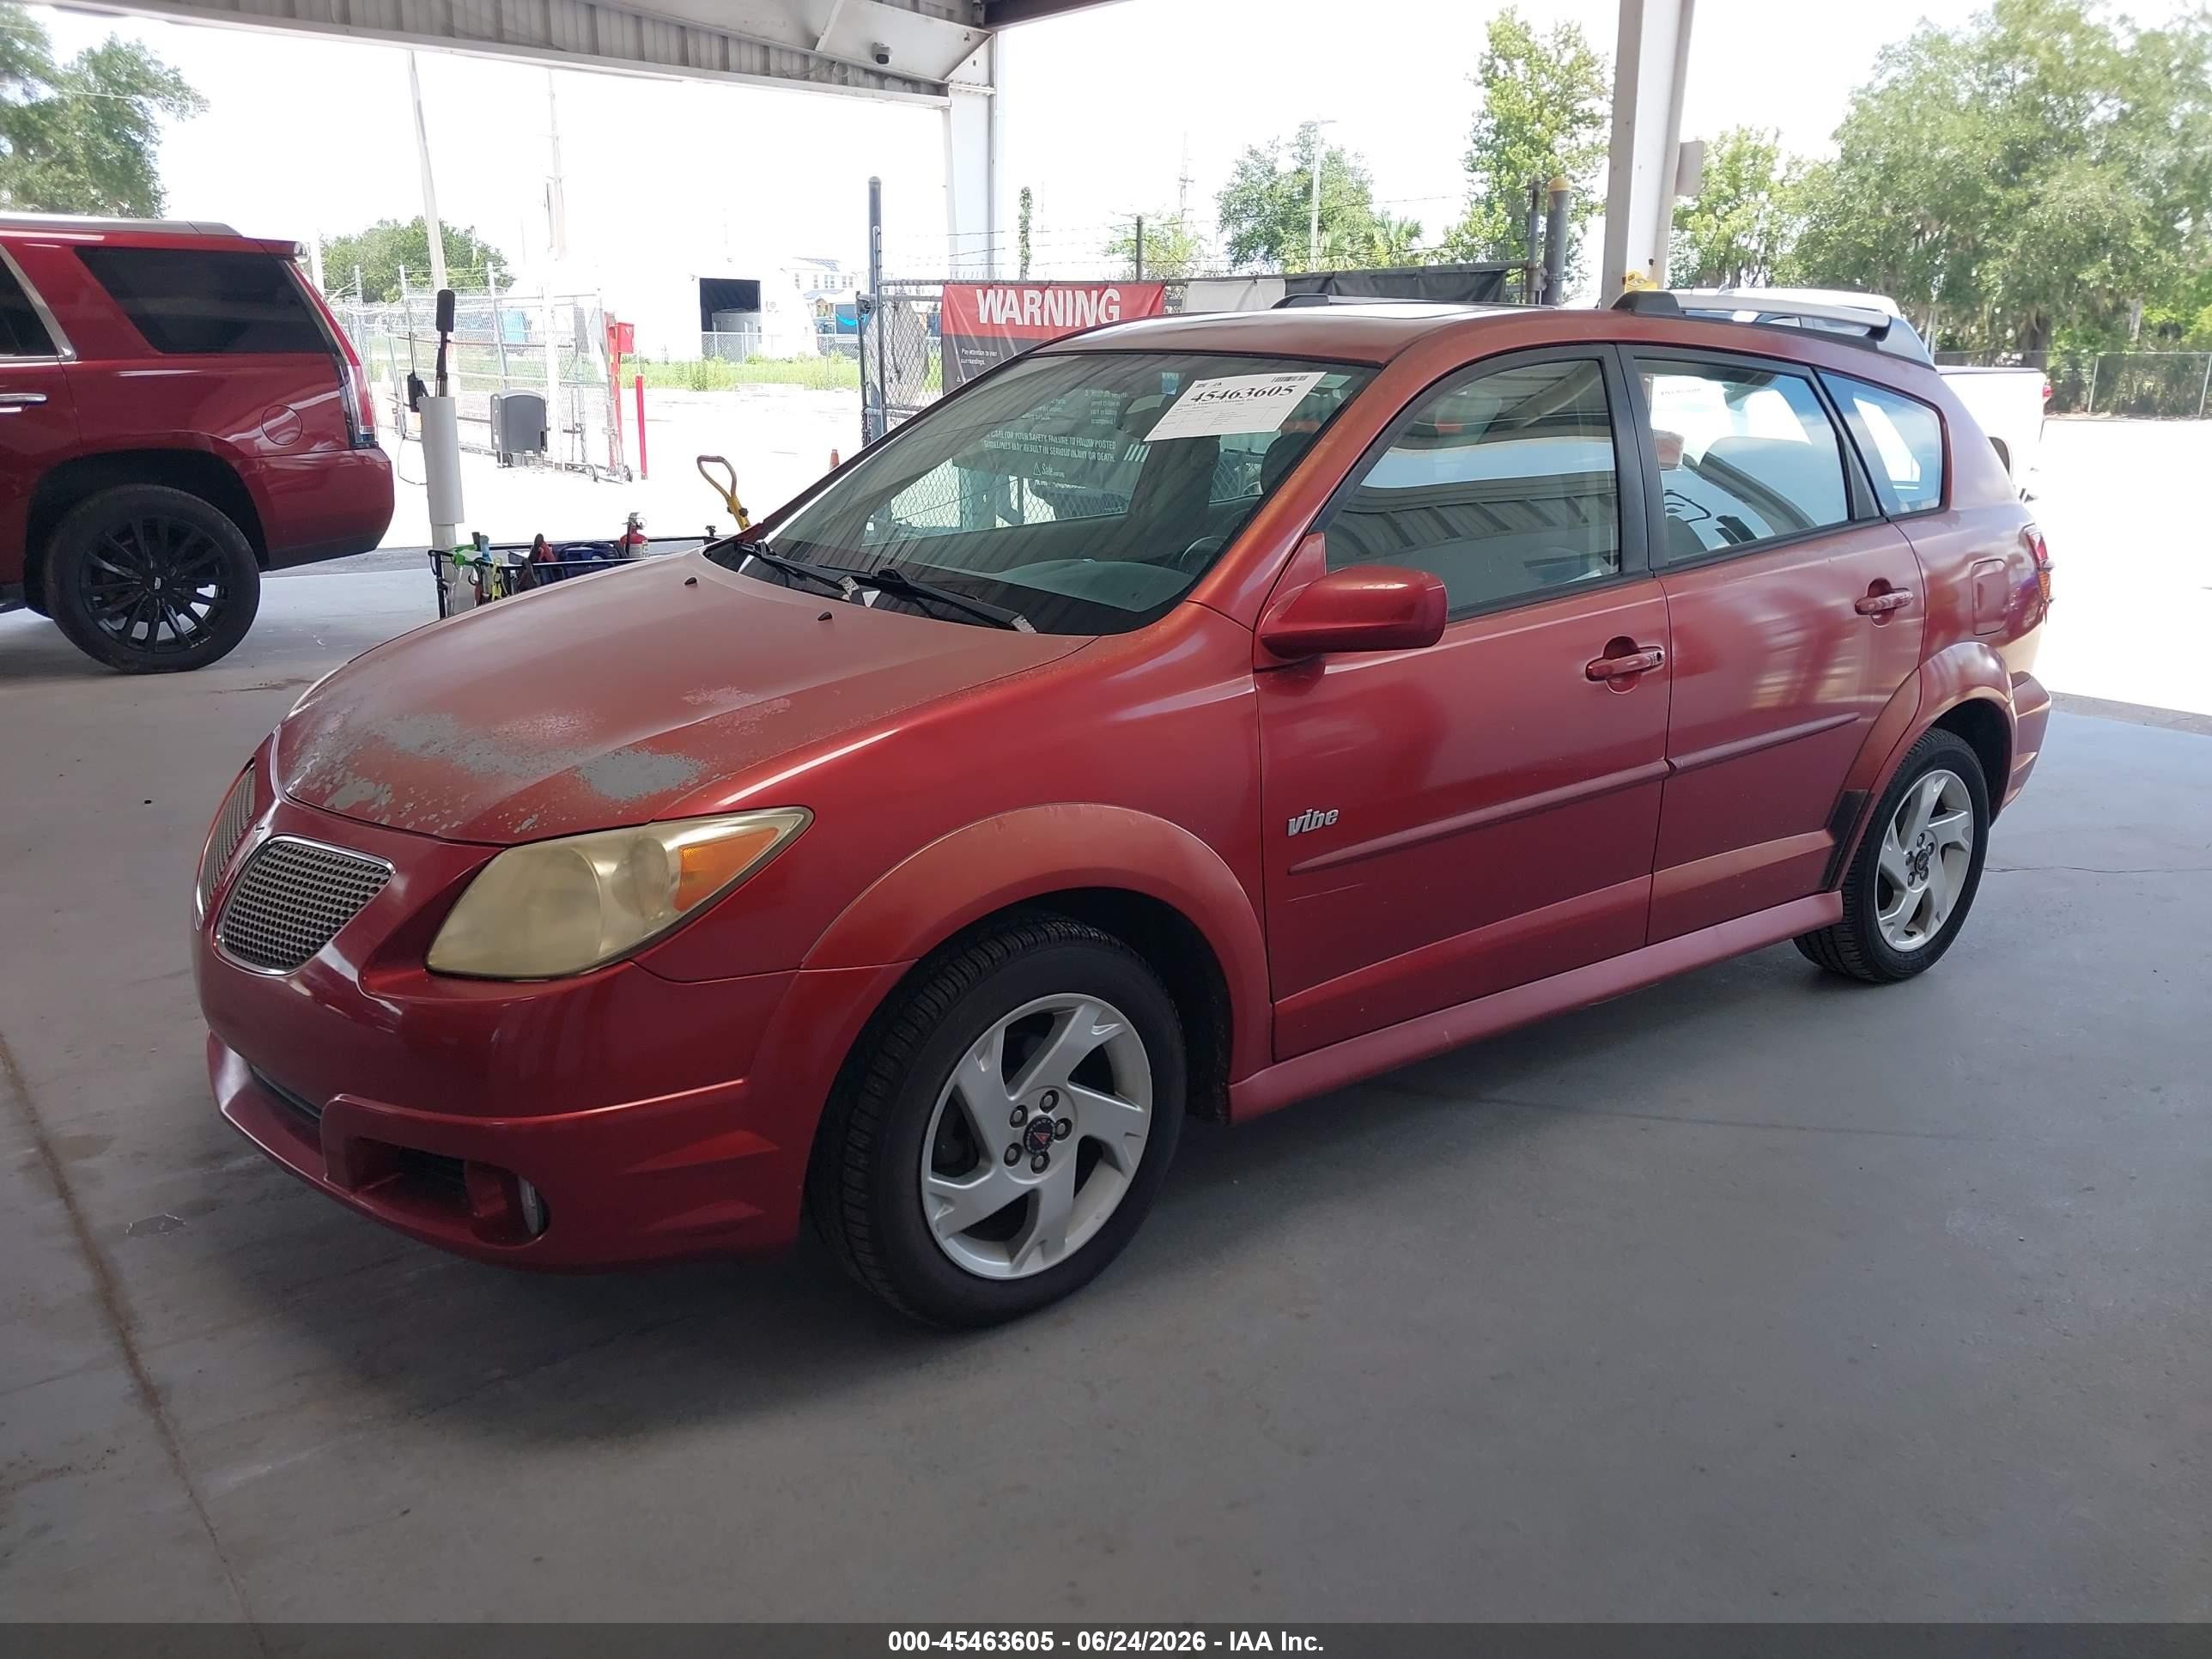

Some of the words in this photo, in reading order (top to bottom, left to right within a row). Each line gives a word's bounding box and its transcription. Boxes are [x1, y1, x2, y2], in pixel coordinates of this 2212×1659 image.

[975, 289, 1121, 327] WARNING
[1190, 385, 1297, 403] 45463605
[1015, 432, 1029, 441] YOUR
[1095, 439, 1115, 449] POSTED
[1024, 443, 1042, 453] RESULT
[1088, 451, 1096, 460] OR
[1288, 808, 1339, 836] vibe
